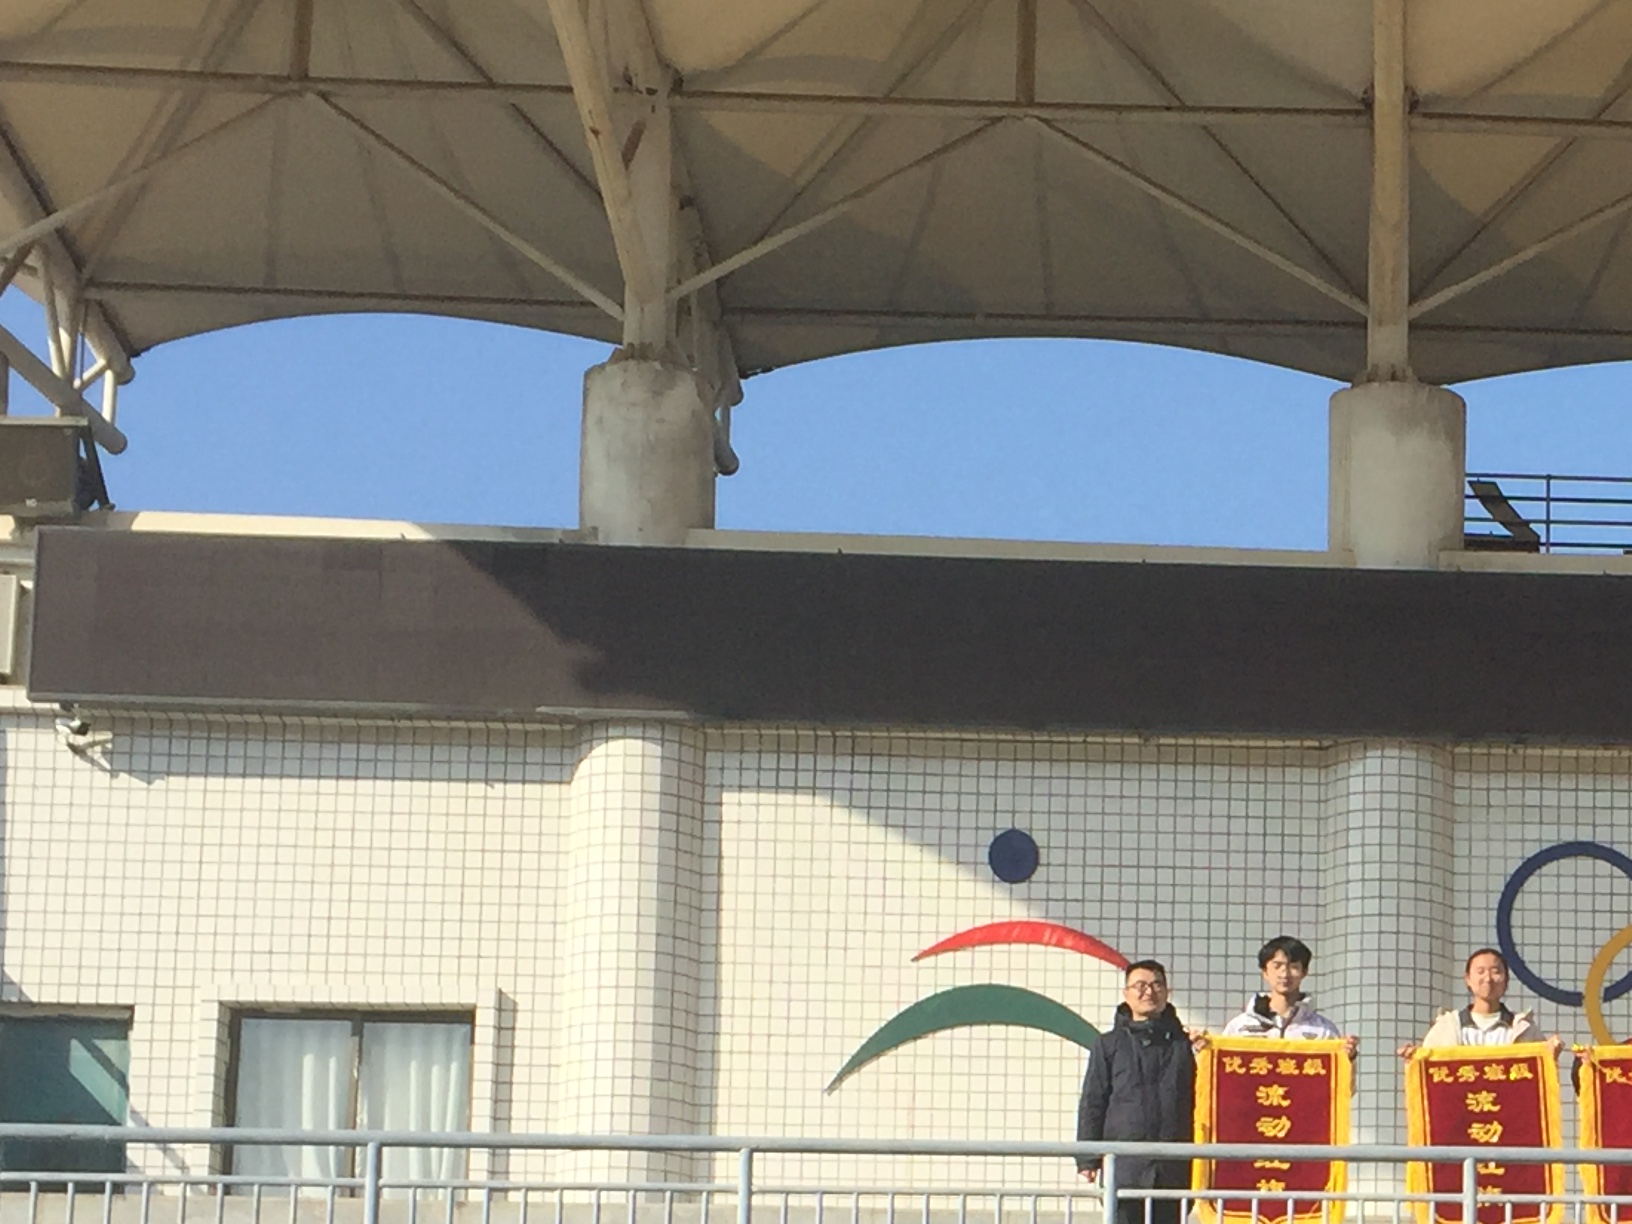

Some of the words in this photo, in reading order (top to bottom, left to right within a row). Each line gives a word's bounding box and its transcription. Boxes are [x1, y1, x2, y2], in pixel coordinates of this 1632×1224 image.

[1222, 1056, 1326, 1075] 优秀班级
[1429, 1063, 1533, 1083] 优秀班级
